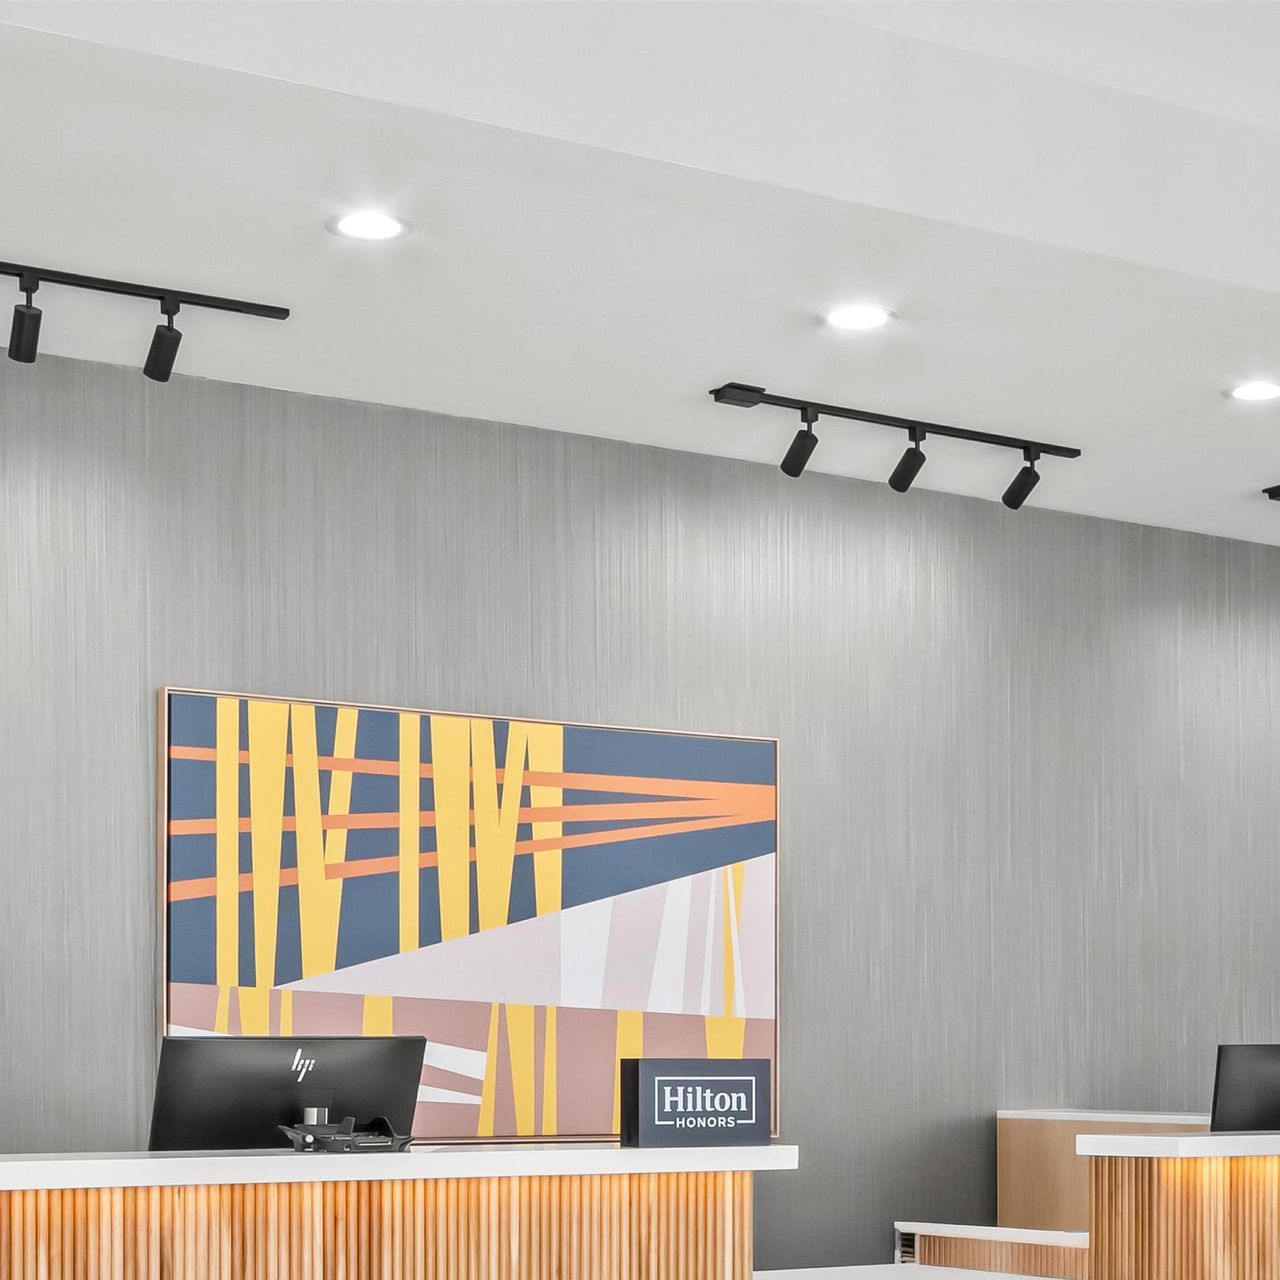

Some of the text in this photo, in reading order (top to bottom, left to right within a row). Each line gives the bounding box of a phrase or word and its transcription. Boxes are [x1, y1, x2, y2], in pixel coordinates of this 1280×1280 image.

[291, 1048, 316, 1082] hp
[663, 1086, 748, 1112] Hilton
[676, 1116, 736, 1129] HONORS
